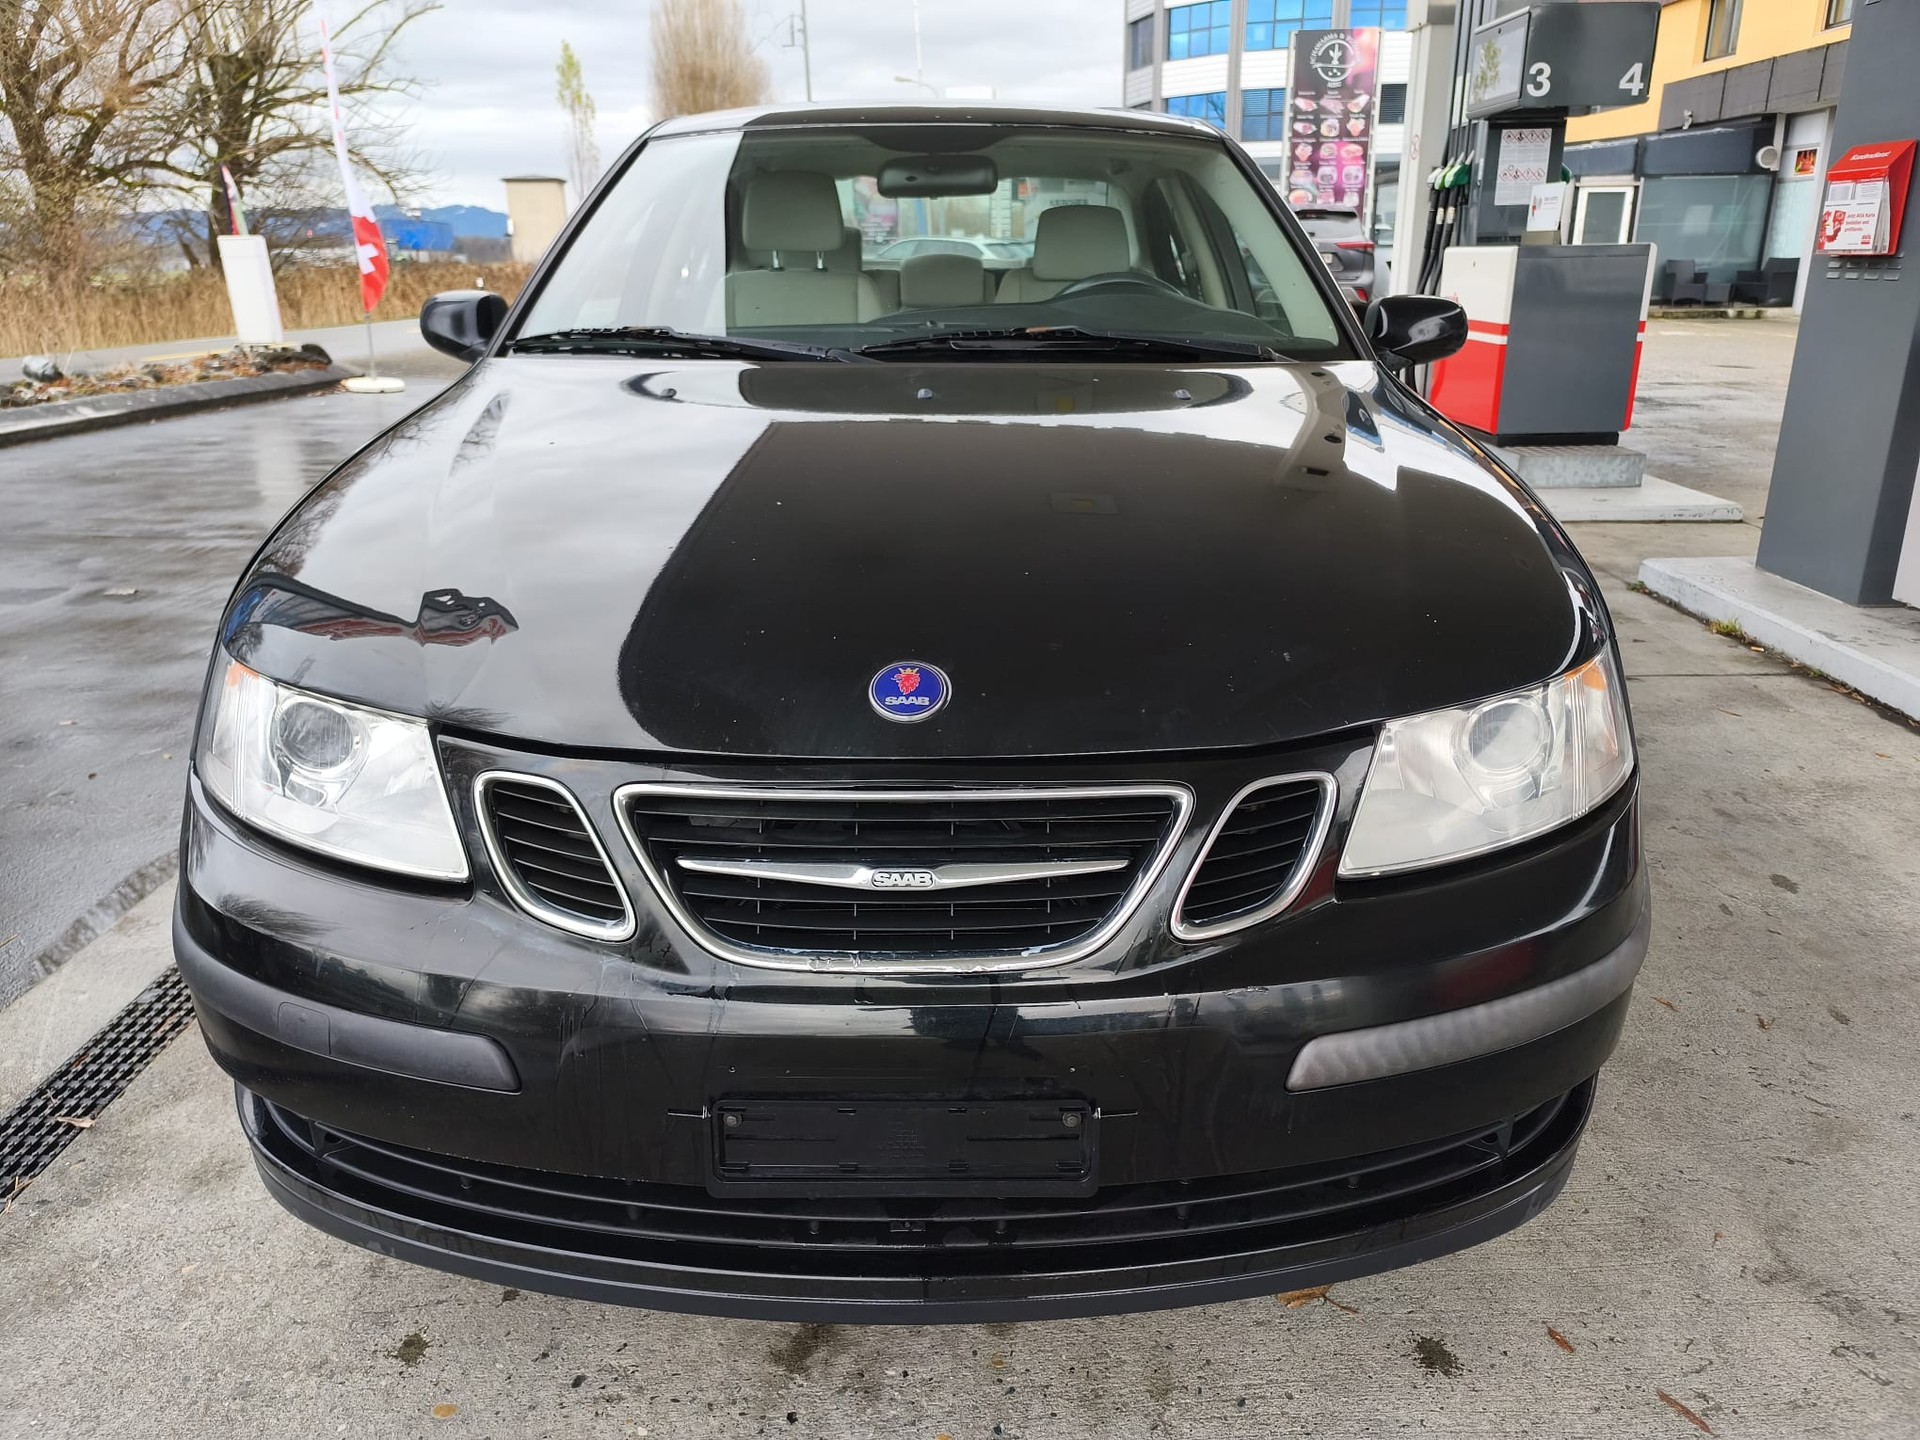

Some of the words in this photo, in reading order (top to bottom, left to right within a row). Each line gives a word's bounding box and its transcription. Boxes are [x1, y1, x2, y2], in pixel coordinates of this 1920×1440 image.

[1526, 62, 1551, 97] 3
[1618, 62, 1644, 96] 4
[885, 696, 930, 705] SAAB
[874, 872, 932, 887] SAAB
